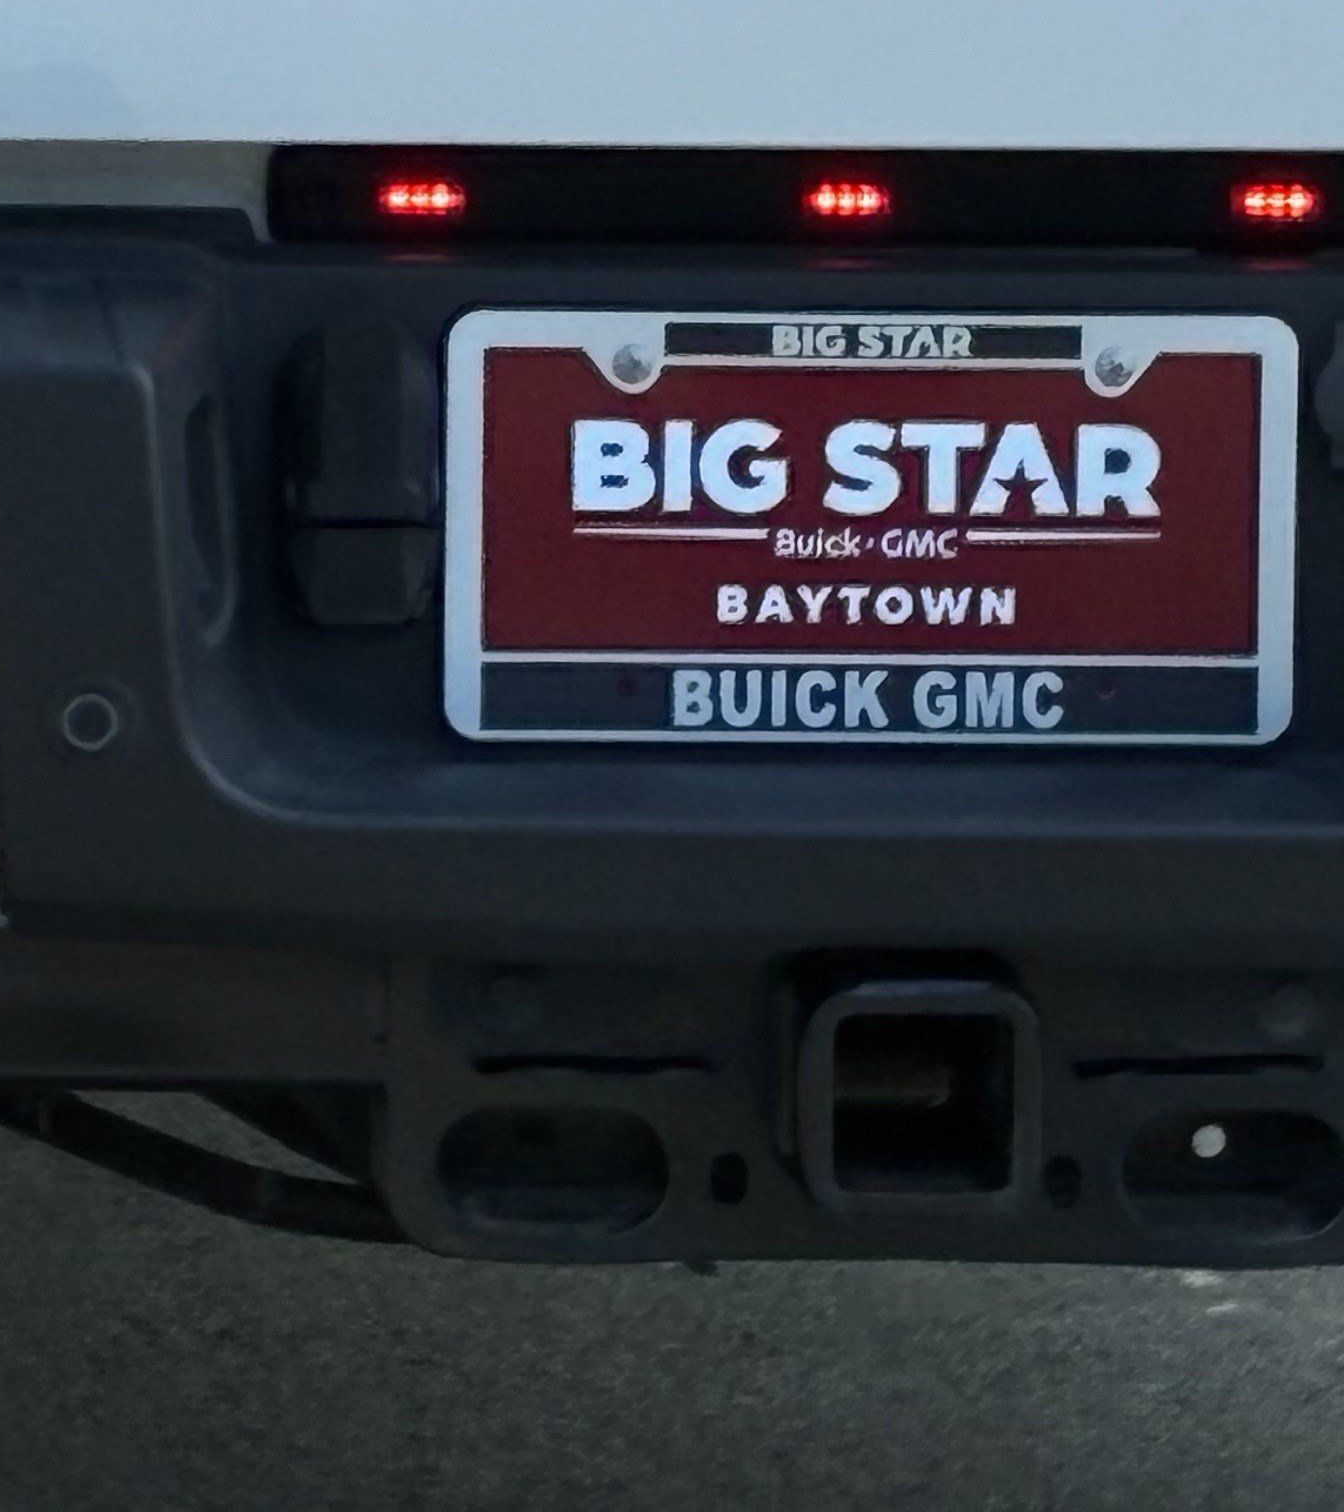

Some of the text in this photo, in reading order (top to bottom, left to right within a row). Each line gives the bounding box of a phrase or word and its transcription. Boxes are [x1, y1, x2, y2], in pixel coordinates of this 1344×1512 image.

[772, 325, 973, 358] BIG STAR
[571, 418, 1163, 518] BIG STAR
[716, 584, 1018, 626] BAYTOWN
[670, 669, 1065, 729] BUICK GMC
